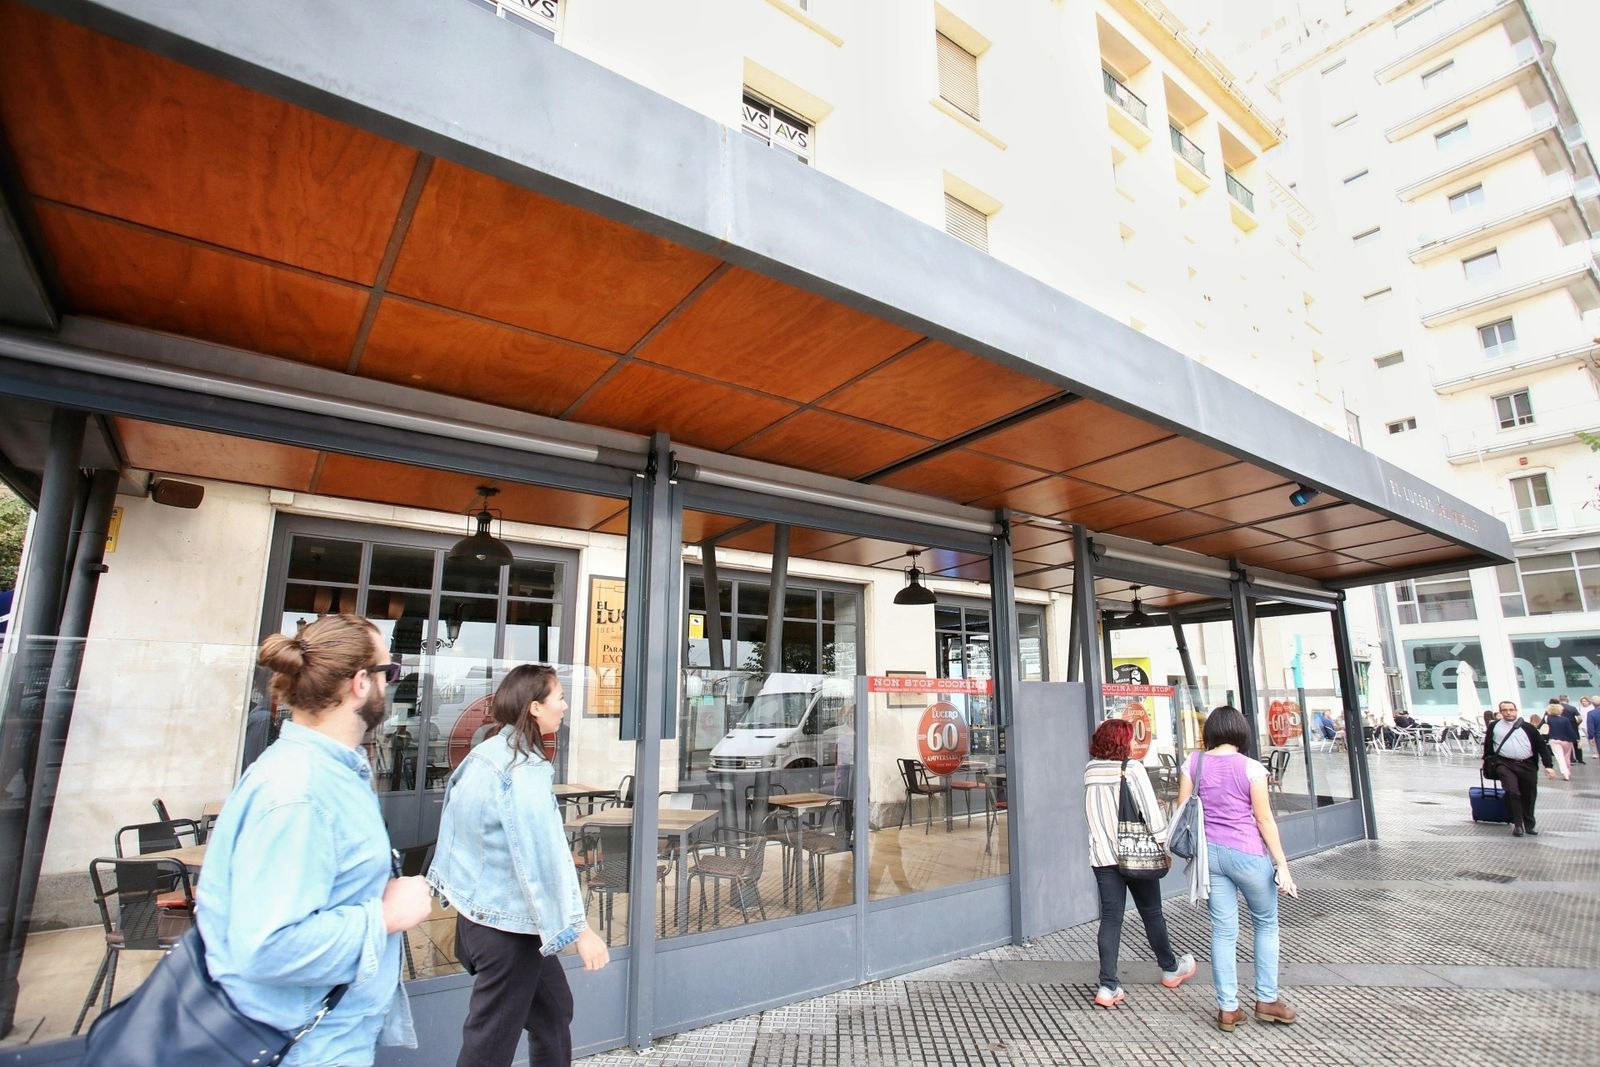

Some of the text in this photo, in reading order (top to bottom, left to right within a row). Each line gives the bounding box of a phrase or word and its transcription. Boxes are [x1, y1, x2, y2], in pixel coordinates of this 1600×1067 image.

[775, 123, 807, 148] AVS
[596, 601, 615, 612] EL
[873, 678, 900, 687] NON
[904, 679, 934, 688] STOP
[1134, 685, 1149, 693] NON
[1272, 714, 1285, 731] 60
[927, 722, 958, 752] 60
